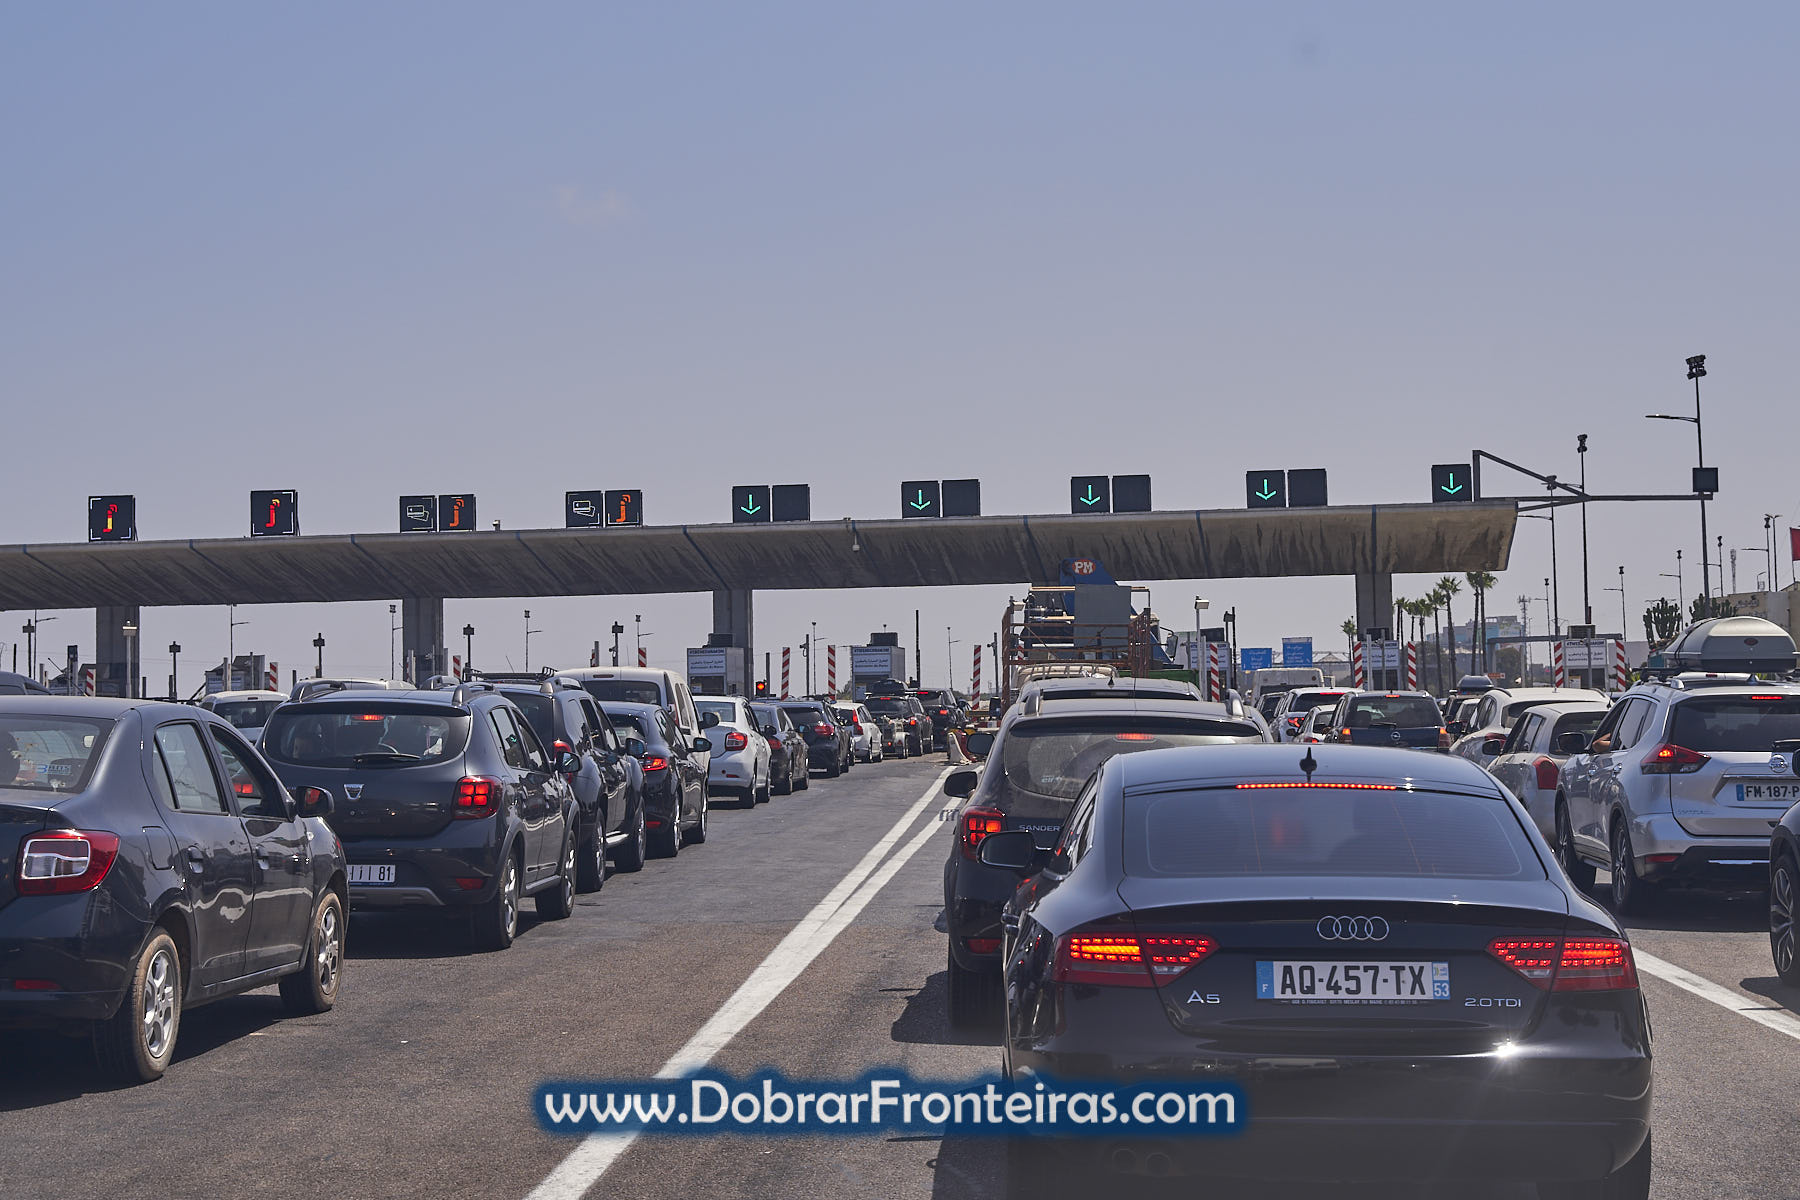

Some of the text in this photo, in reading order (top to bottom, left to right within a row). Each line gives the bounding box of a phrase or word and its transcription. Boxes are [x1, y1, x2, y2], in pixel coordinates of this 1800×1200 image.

[1074, 561, 1094, 574] PM
[378, 866, 391, 881] 81
[1262, 965, 1449, 997] F AQ-457-TX 53
[1186, 990, 1221, 1003] A5
